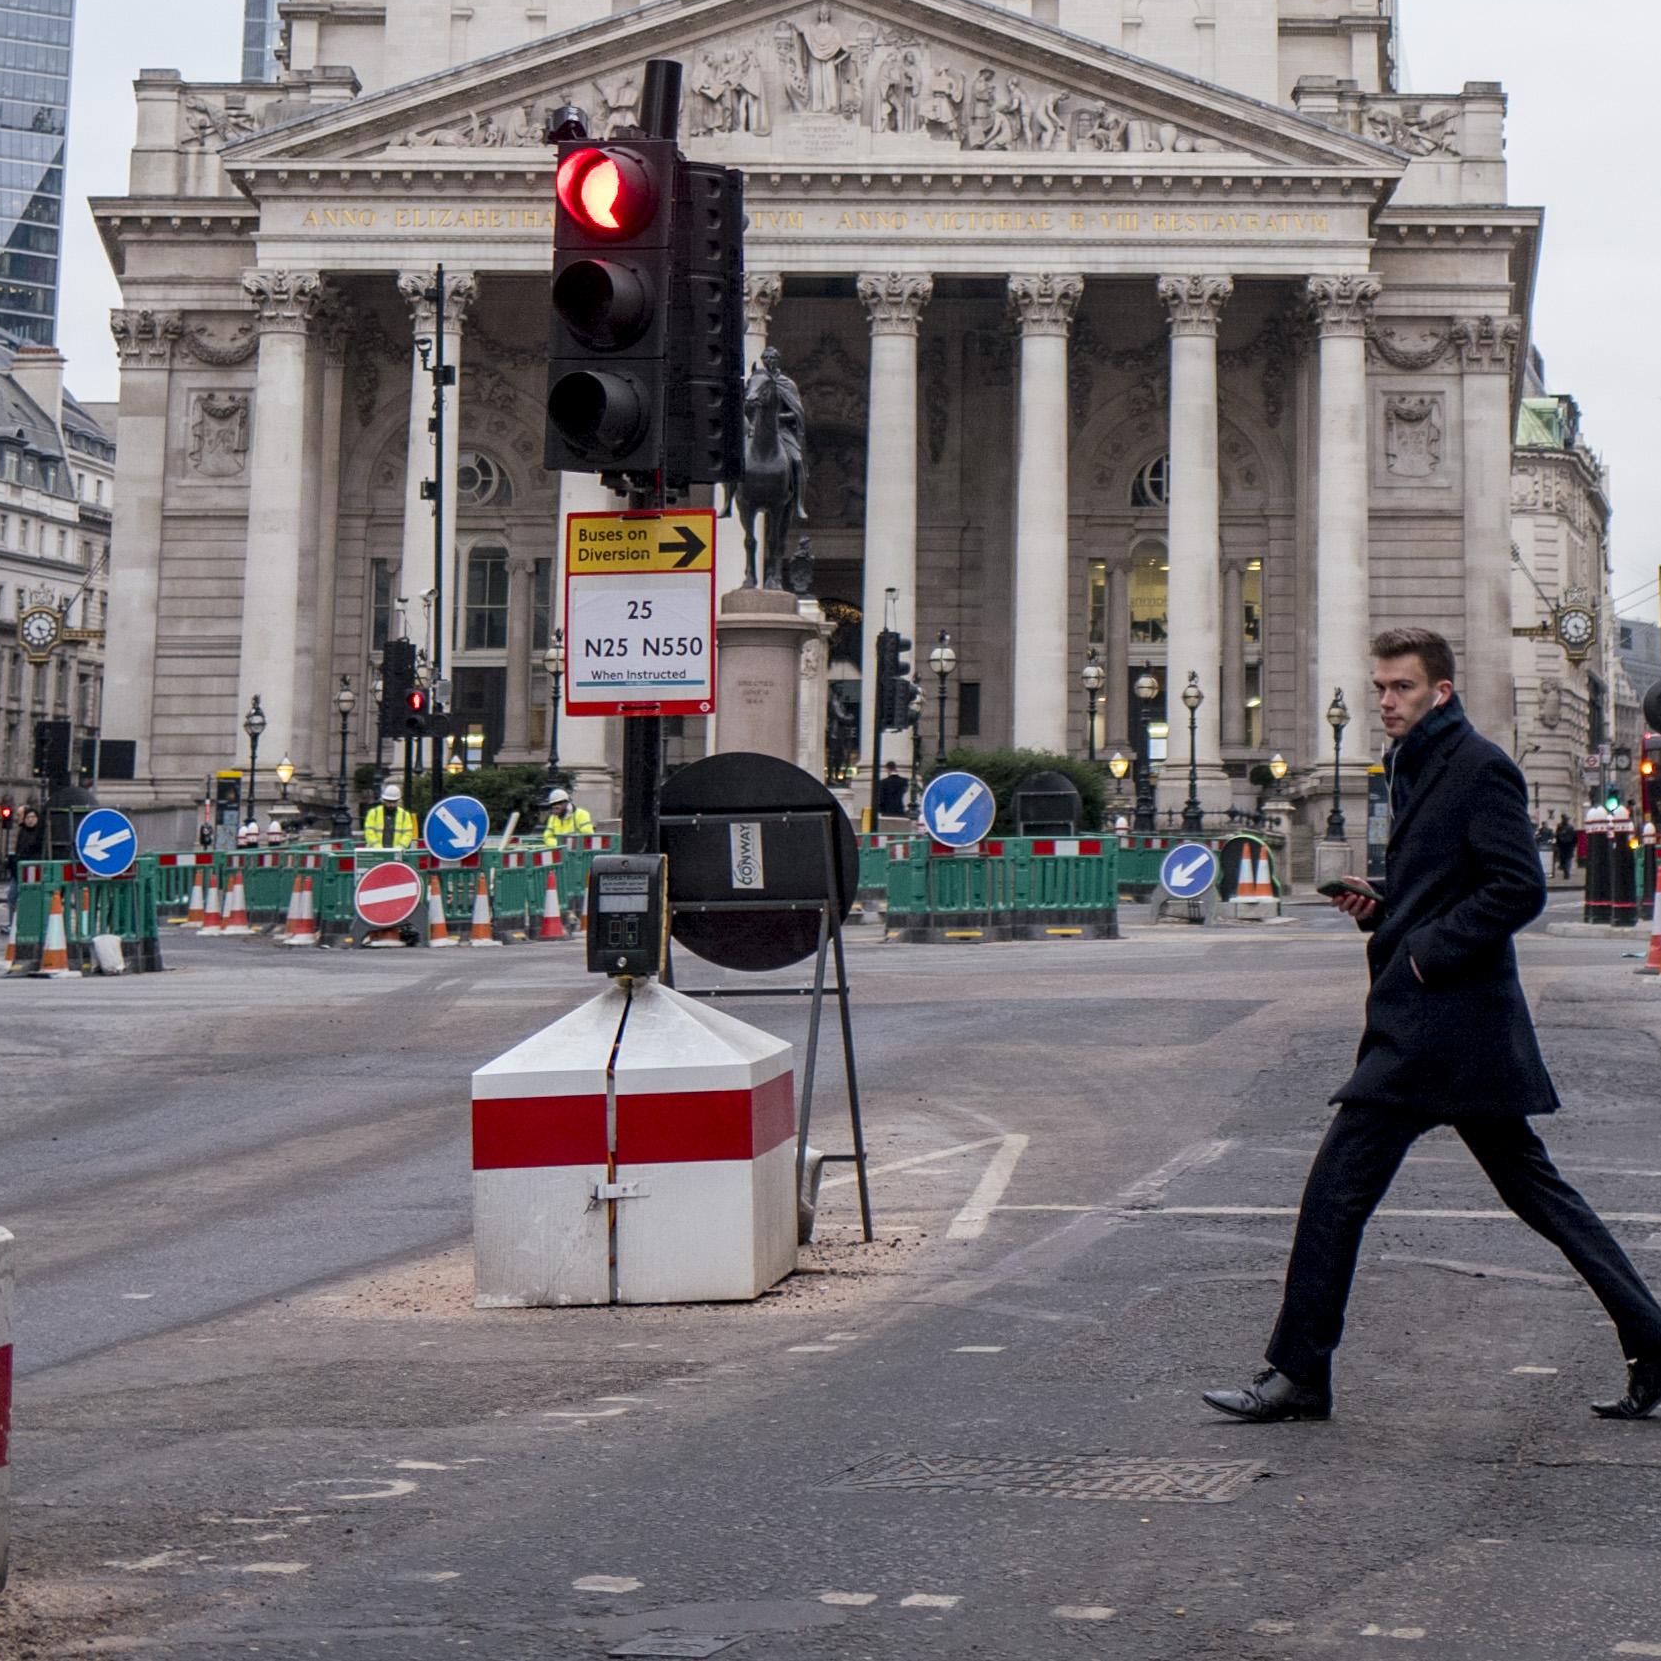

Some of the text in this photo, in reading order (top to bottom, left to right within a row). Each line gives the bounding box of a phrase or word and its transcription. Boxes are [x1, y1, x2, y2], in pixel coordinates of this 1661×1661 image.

[302, 209, 376, 227] ANNO
[836, 211, 907, 230] ANNO
[924, 211, 1054, 232] VICTORIAE
[1069, 213, 1085, 231] R
[1101, 213, 1138, 231] VIII
[1153, 213, 1328, 232] RESTAVRATVM
[579, 529, 647, 542] Buses on
[578, 548, 650, 561] Diversion
[627, 601, 652, 619] 25
[585, 637, 702, 657] N25 N550
[591, 669, 686, 680] When Instructed
[740, 824, 753, 886] CONWAY
